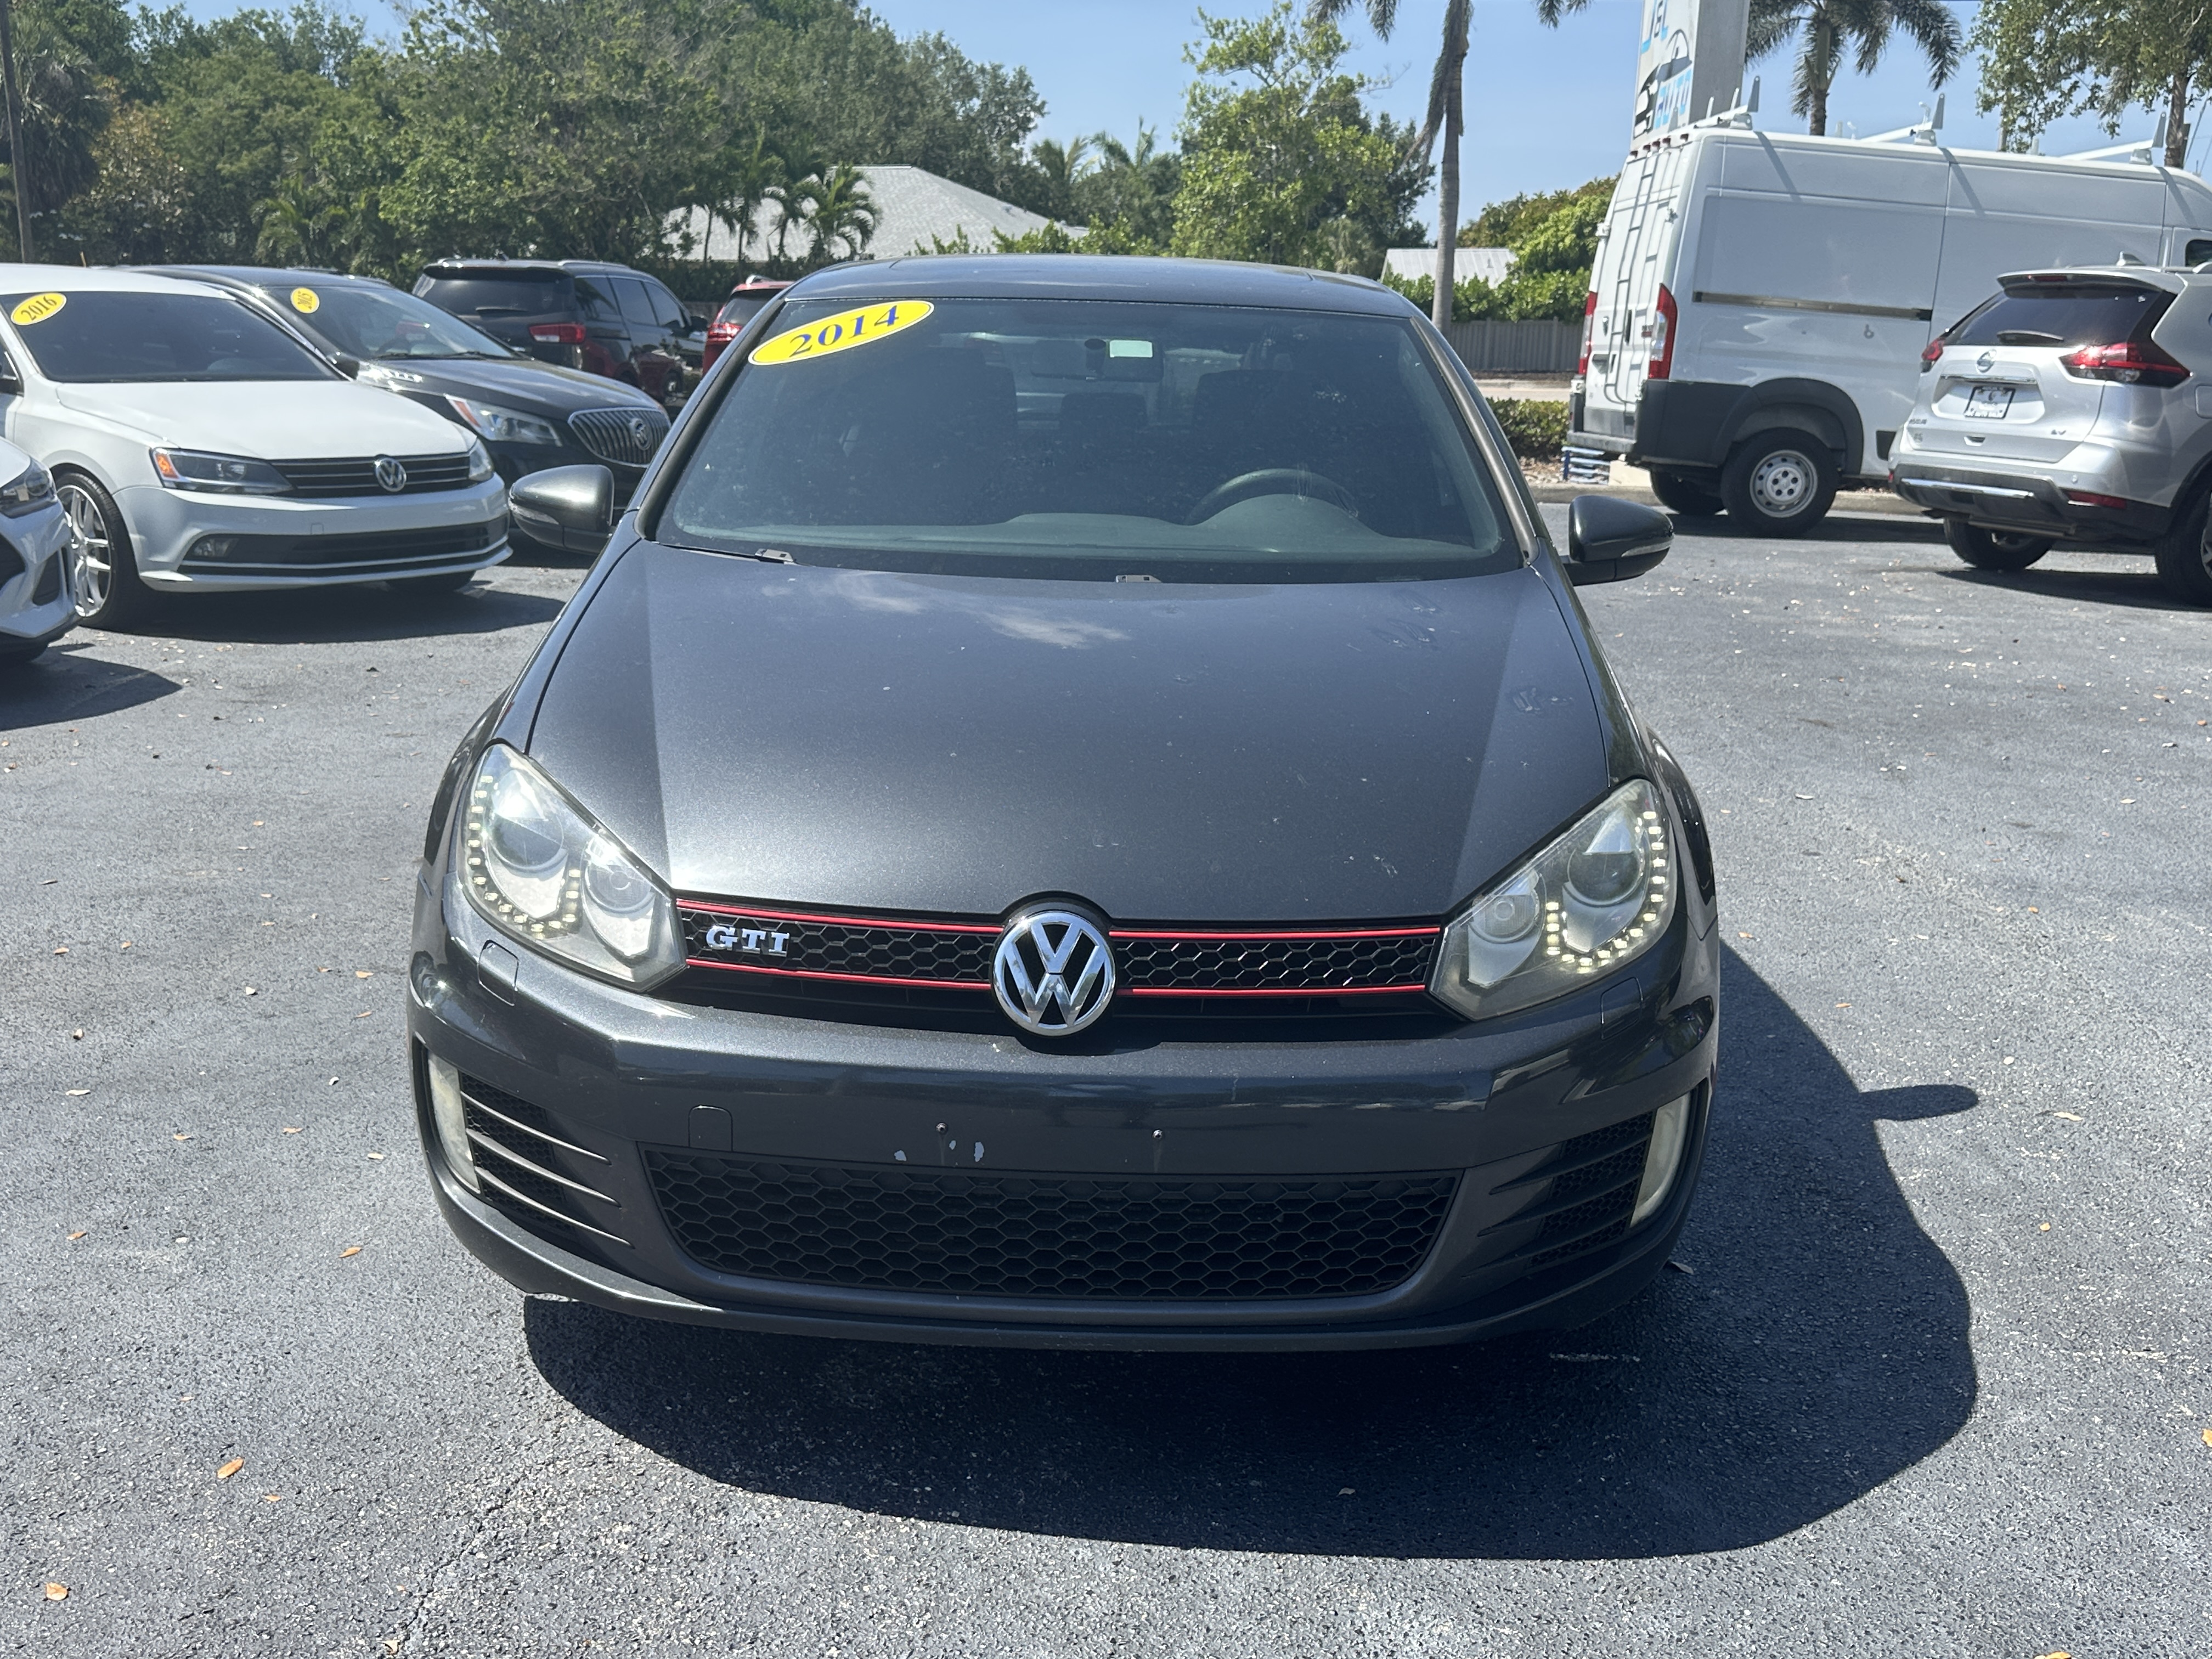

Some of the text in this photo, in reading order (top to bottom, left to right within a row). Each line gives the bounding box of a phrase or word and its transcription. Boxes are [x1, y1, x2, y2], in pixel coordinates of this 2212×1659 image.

[20, 295, 58, 321] 2016
[788, 304, 900, 358] 2014
[706, 924, 791, 957] GTI
[996, 912, 1114, 1035] VW
